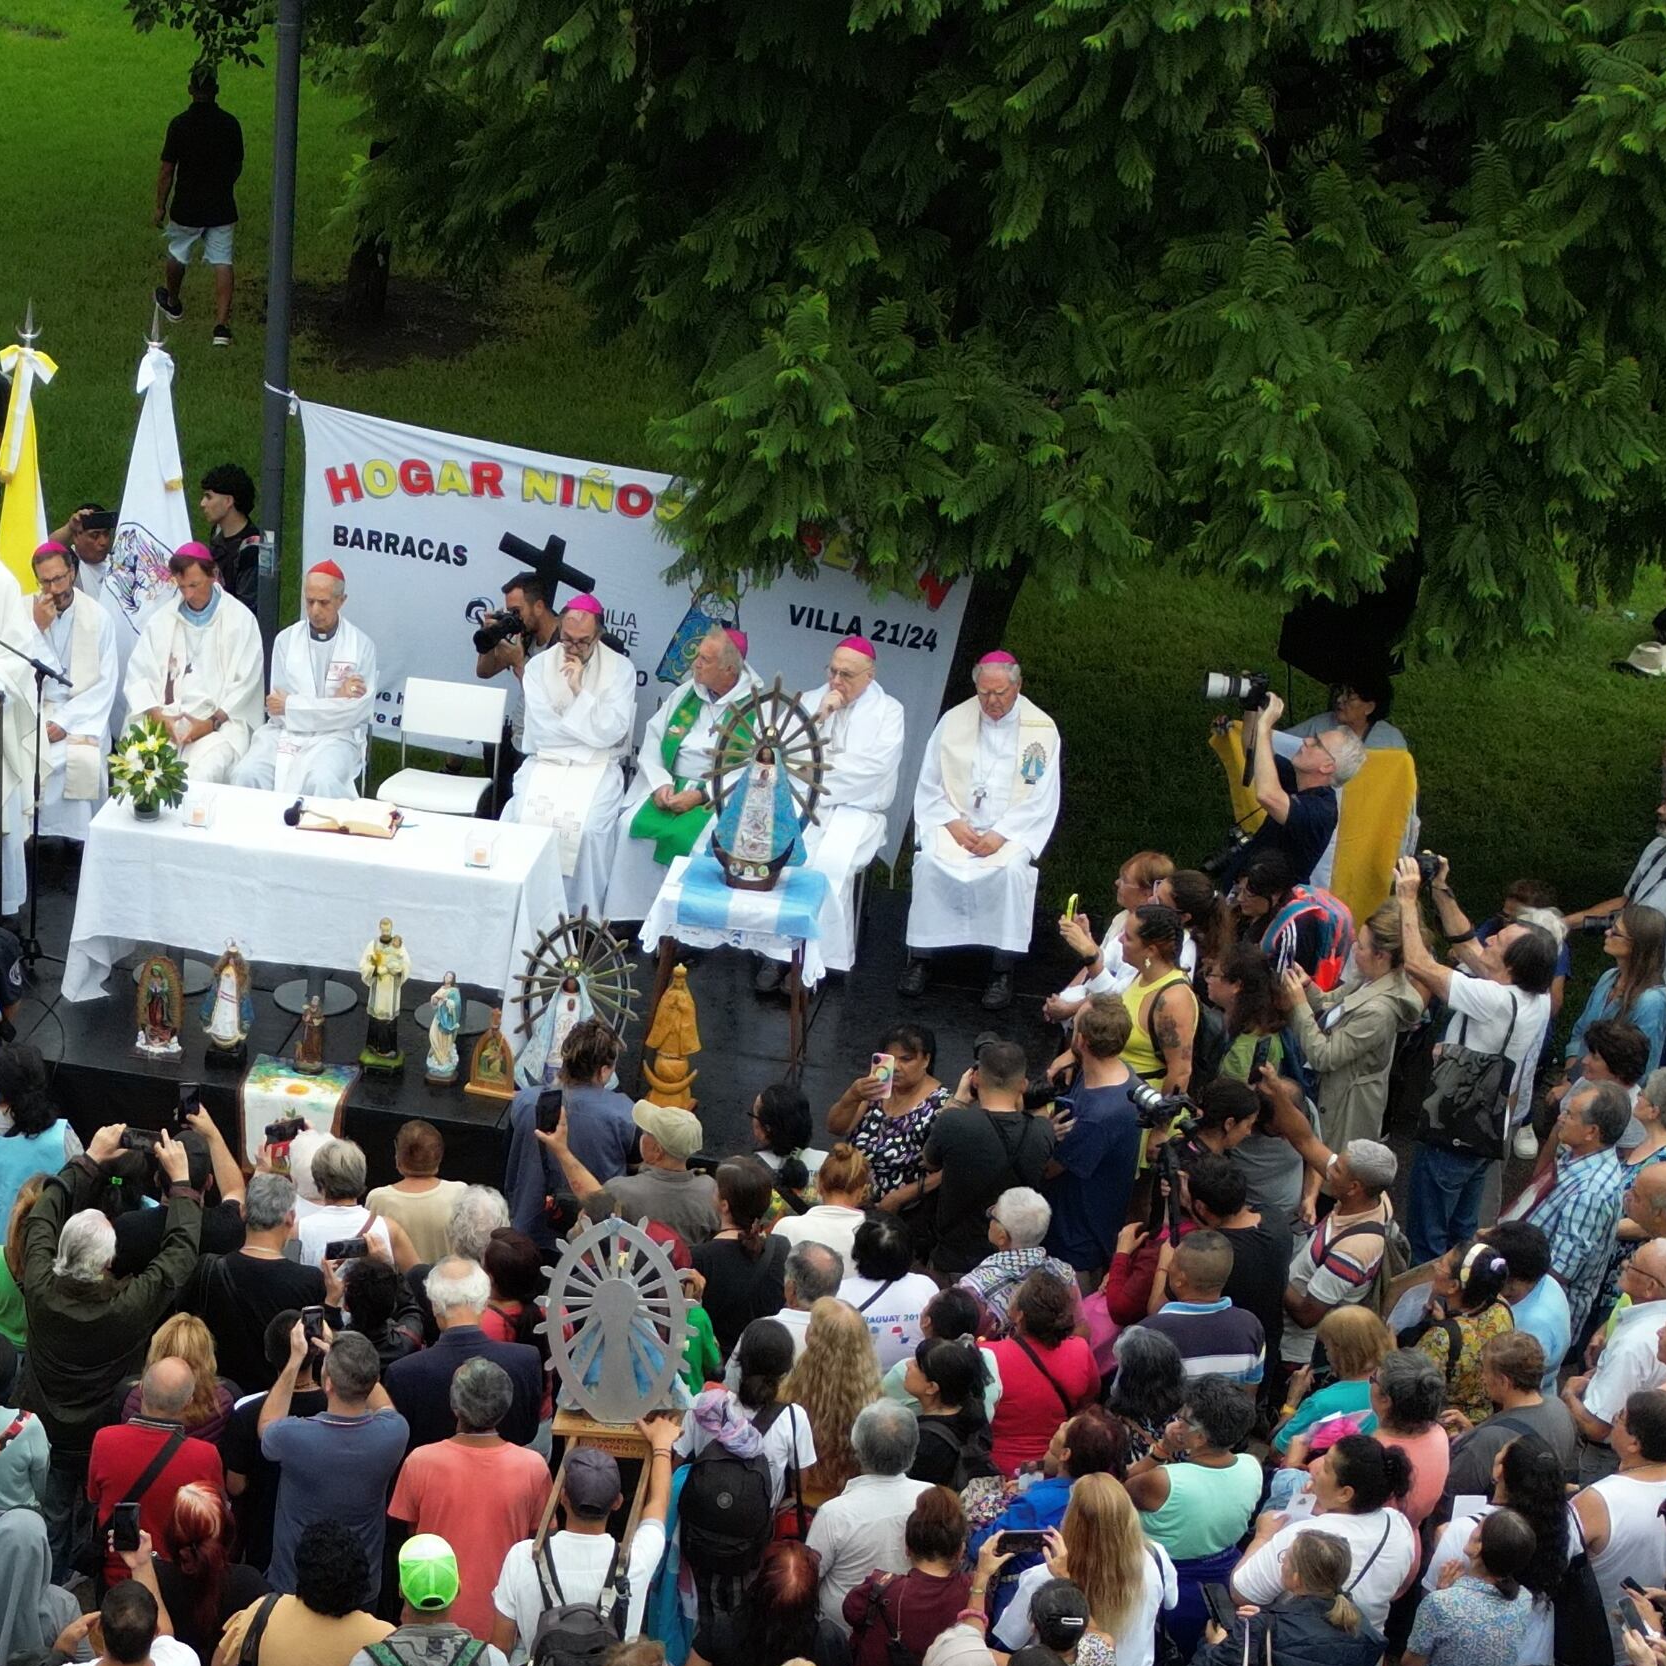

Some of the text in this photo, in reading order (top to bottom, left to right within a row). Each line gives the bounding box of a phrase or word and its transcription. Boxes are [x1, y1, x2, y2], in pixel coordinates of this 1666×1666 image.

[324, 459, 685, 524] HOGAR NIÑOS
[333, 524, 469, 567] BARRACAS
[789, 604, 938, 653] VILLA 21/24
